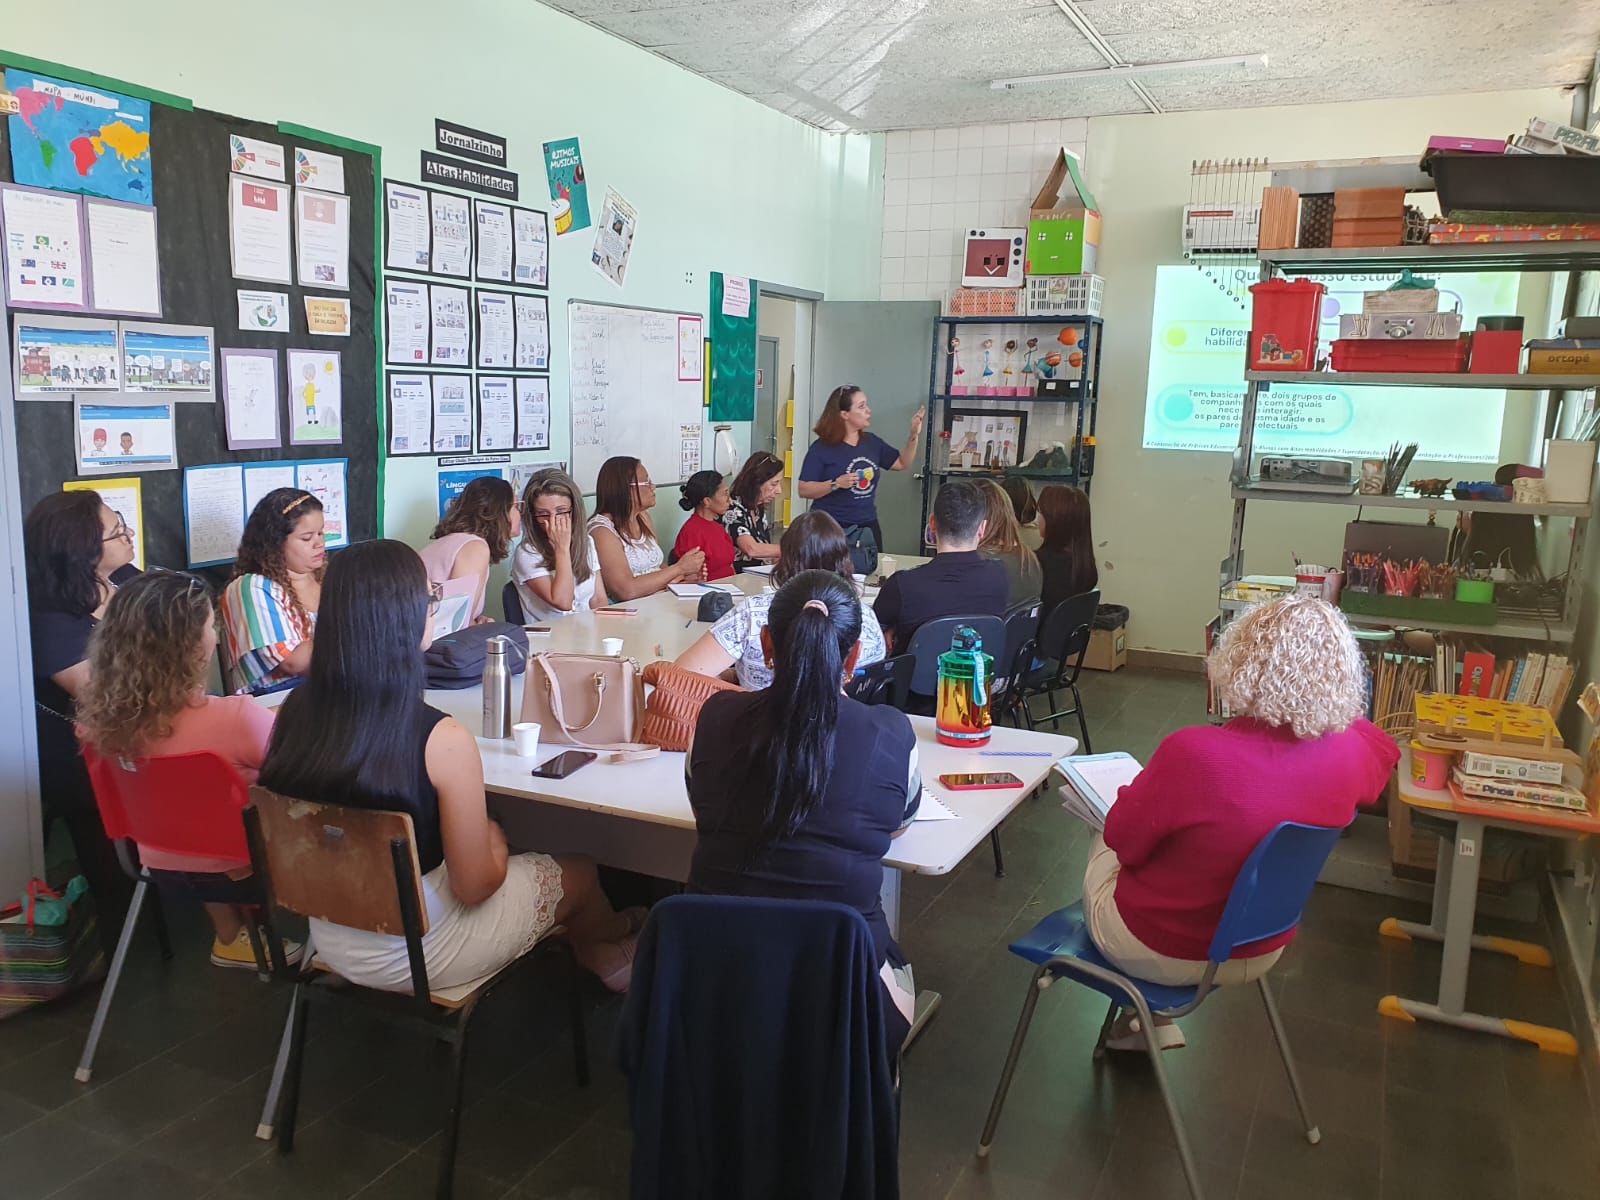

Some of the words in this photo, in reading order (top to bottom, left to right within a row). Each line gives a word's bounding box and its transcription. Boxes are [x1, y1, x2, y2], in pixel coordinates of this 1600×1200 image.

[440, 131, 502, 157] Jornalzinho
[1271, 391, 1291, 399] dois
[1292, 392, 1323, 401] grupos
[1298, 401, 1323, 409] quais
[1280, 414, 1306, 422] idade
